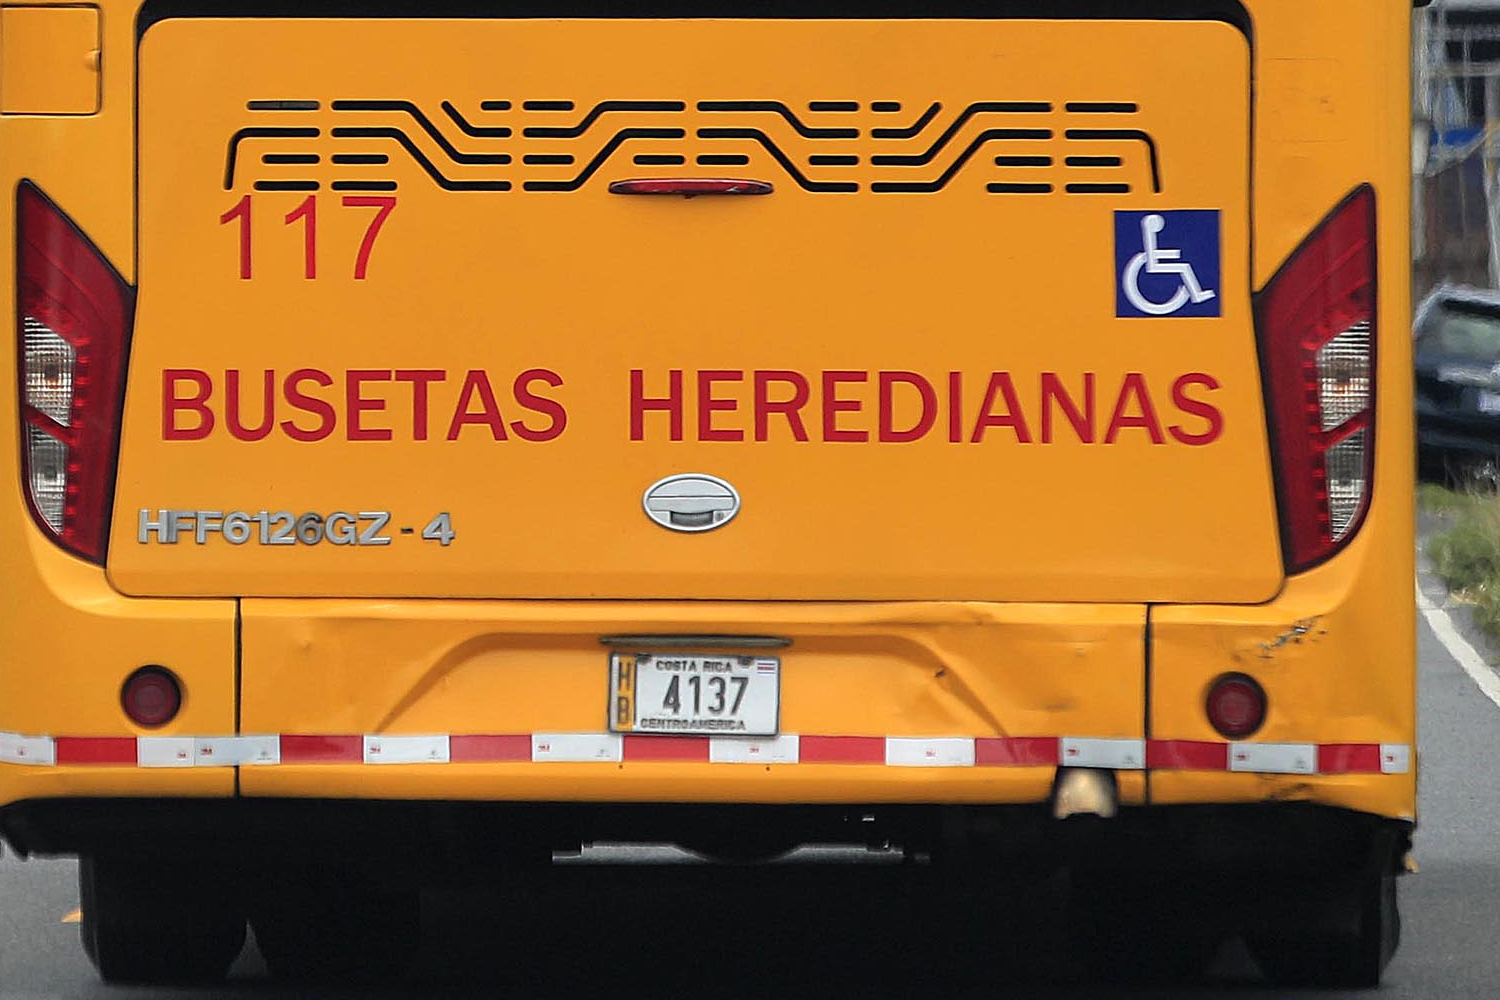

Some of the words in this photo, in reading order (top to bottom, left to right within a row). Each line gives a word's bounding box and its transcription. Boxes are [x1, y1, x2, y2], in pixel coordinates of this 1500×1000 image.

[220, 195, 396, 280] 117
[161, 368, 568, 442] BUSETAS
[629, 369, 1223, 446] HEREDIANAS
[656, 660, 697, 672] COSTA
[703, 661, 732, 672] RICA
[663, 675, 749, 715] 4137
[640, 718, 746, 731] CENTROAMERICA
